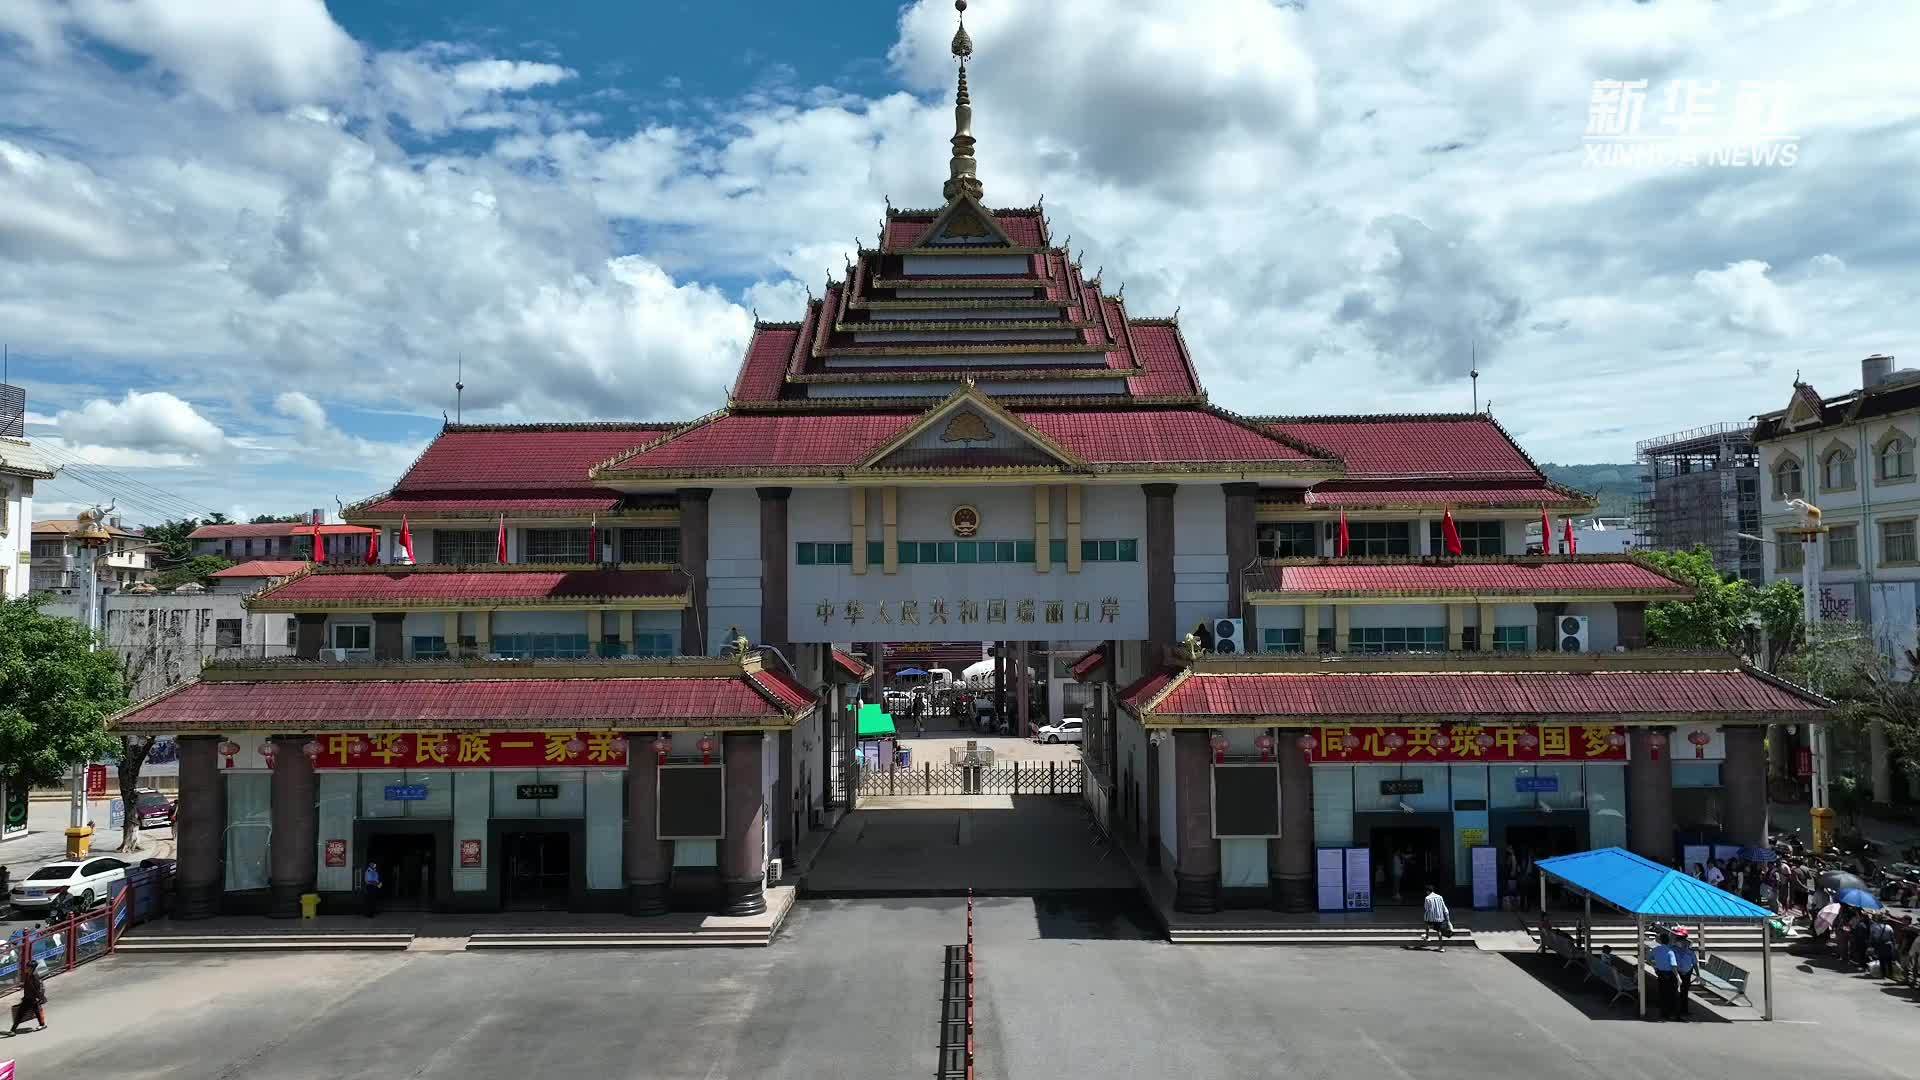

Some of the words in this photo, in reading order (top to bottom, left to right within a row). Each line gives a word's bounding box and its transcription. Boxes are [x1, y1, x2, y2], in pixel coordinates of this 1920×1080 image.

[816, 599, 1120, 625] 中华人民共和国瑞丽口岸
[328, 732, 624, 764] 中华民族一家亲
[1320, 726, 1619, 757] 同心共筑中国梦
